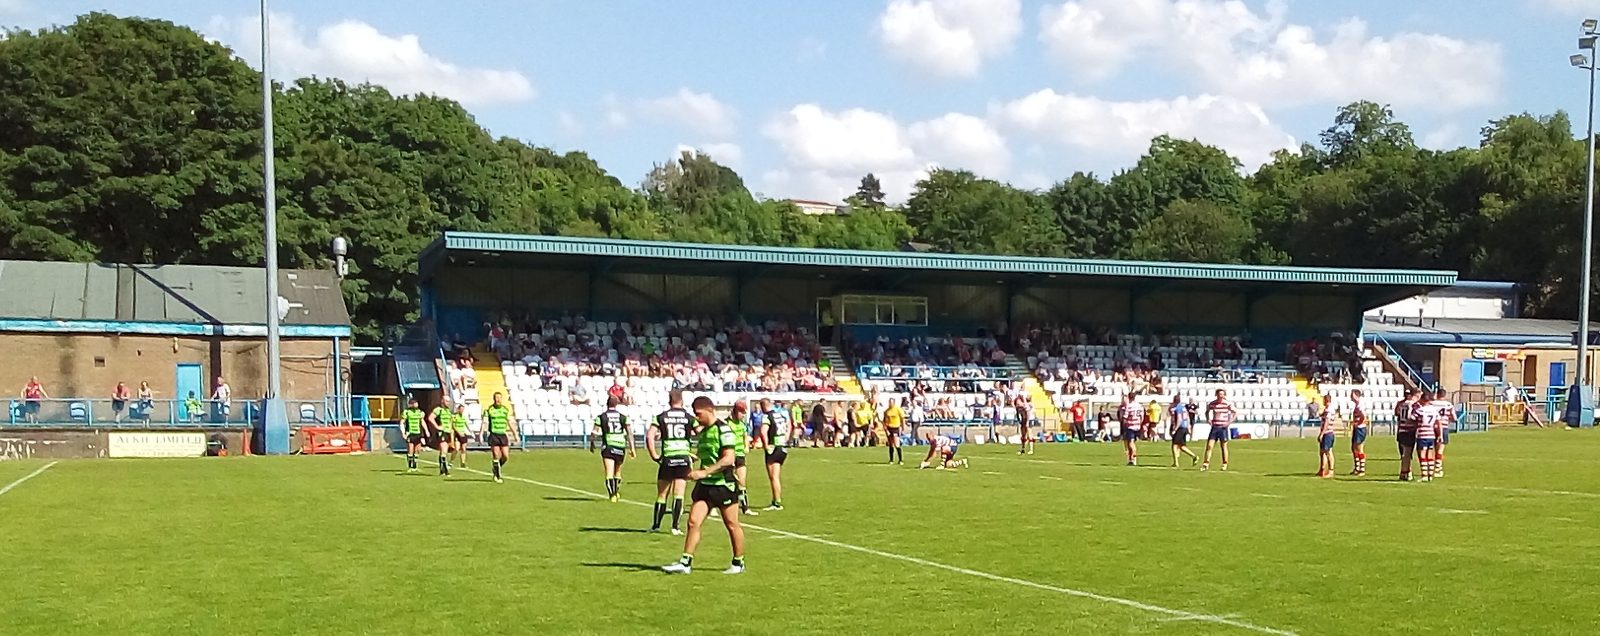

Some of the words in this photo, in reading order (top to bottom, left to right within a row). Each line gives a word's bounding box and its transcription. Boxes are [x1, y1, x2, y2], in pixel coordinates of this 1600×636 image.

[1427, 414, 1434, 424] 7
[608, 422, 622, 433] 12
[667, 423, 686, 439] 16
